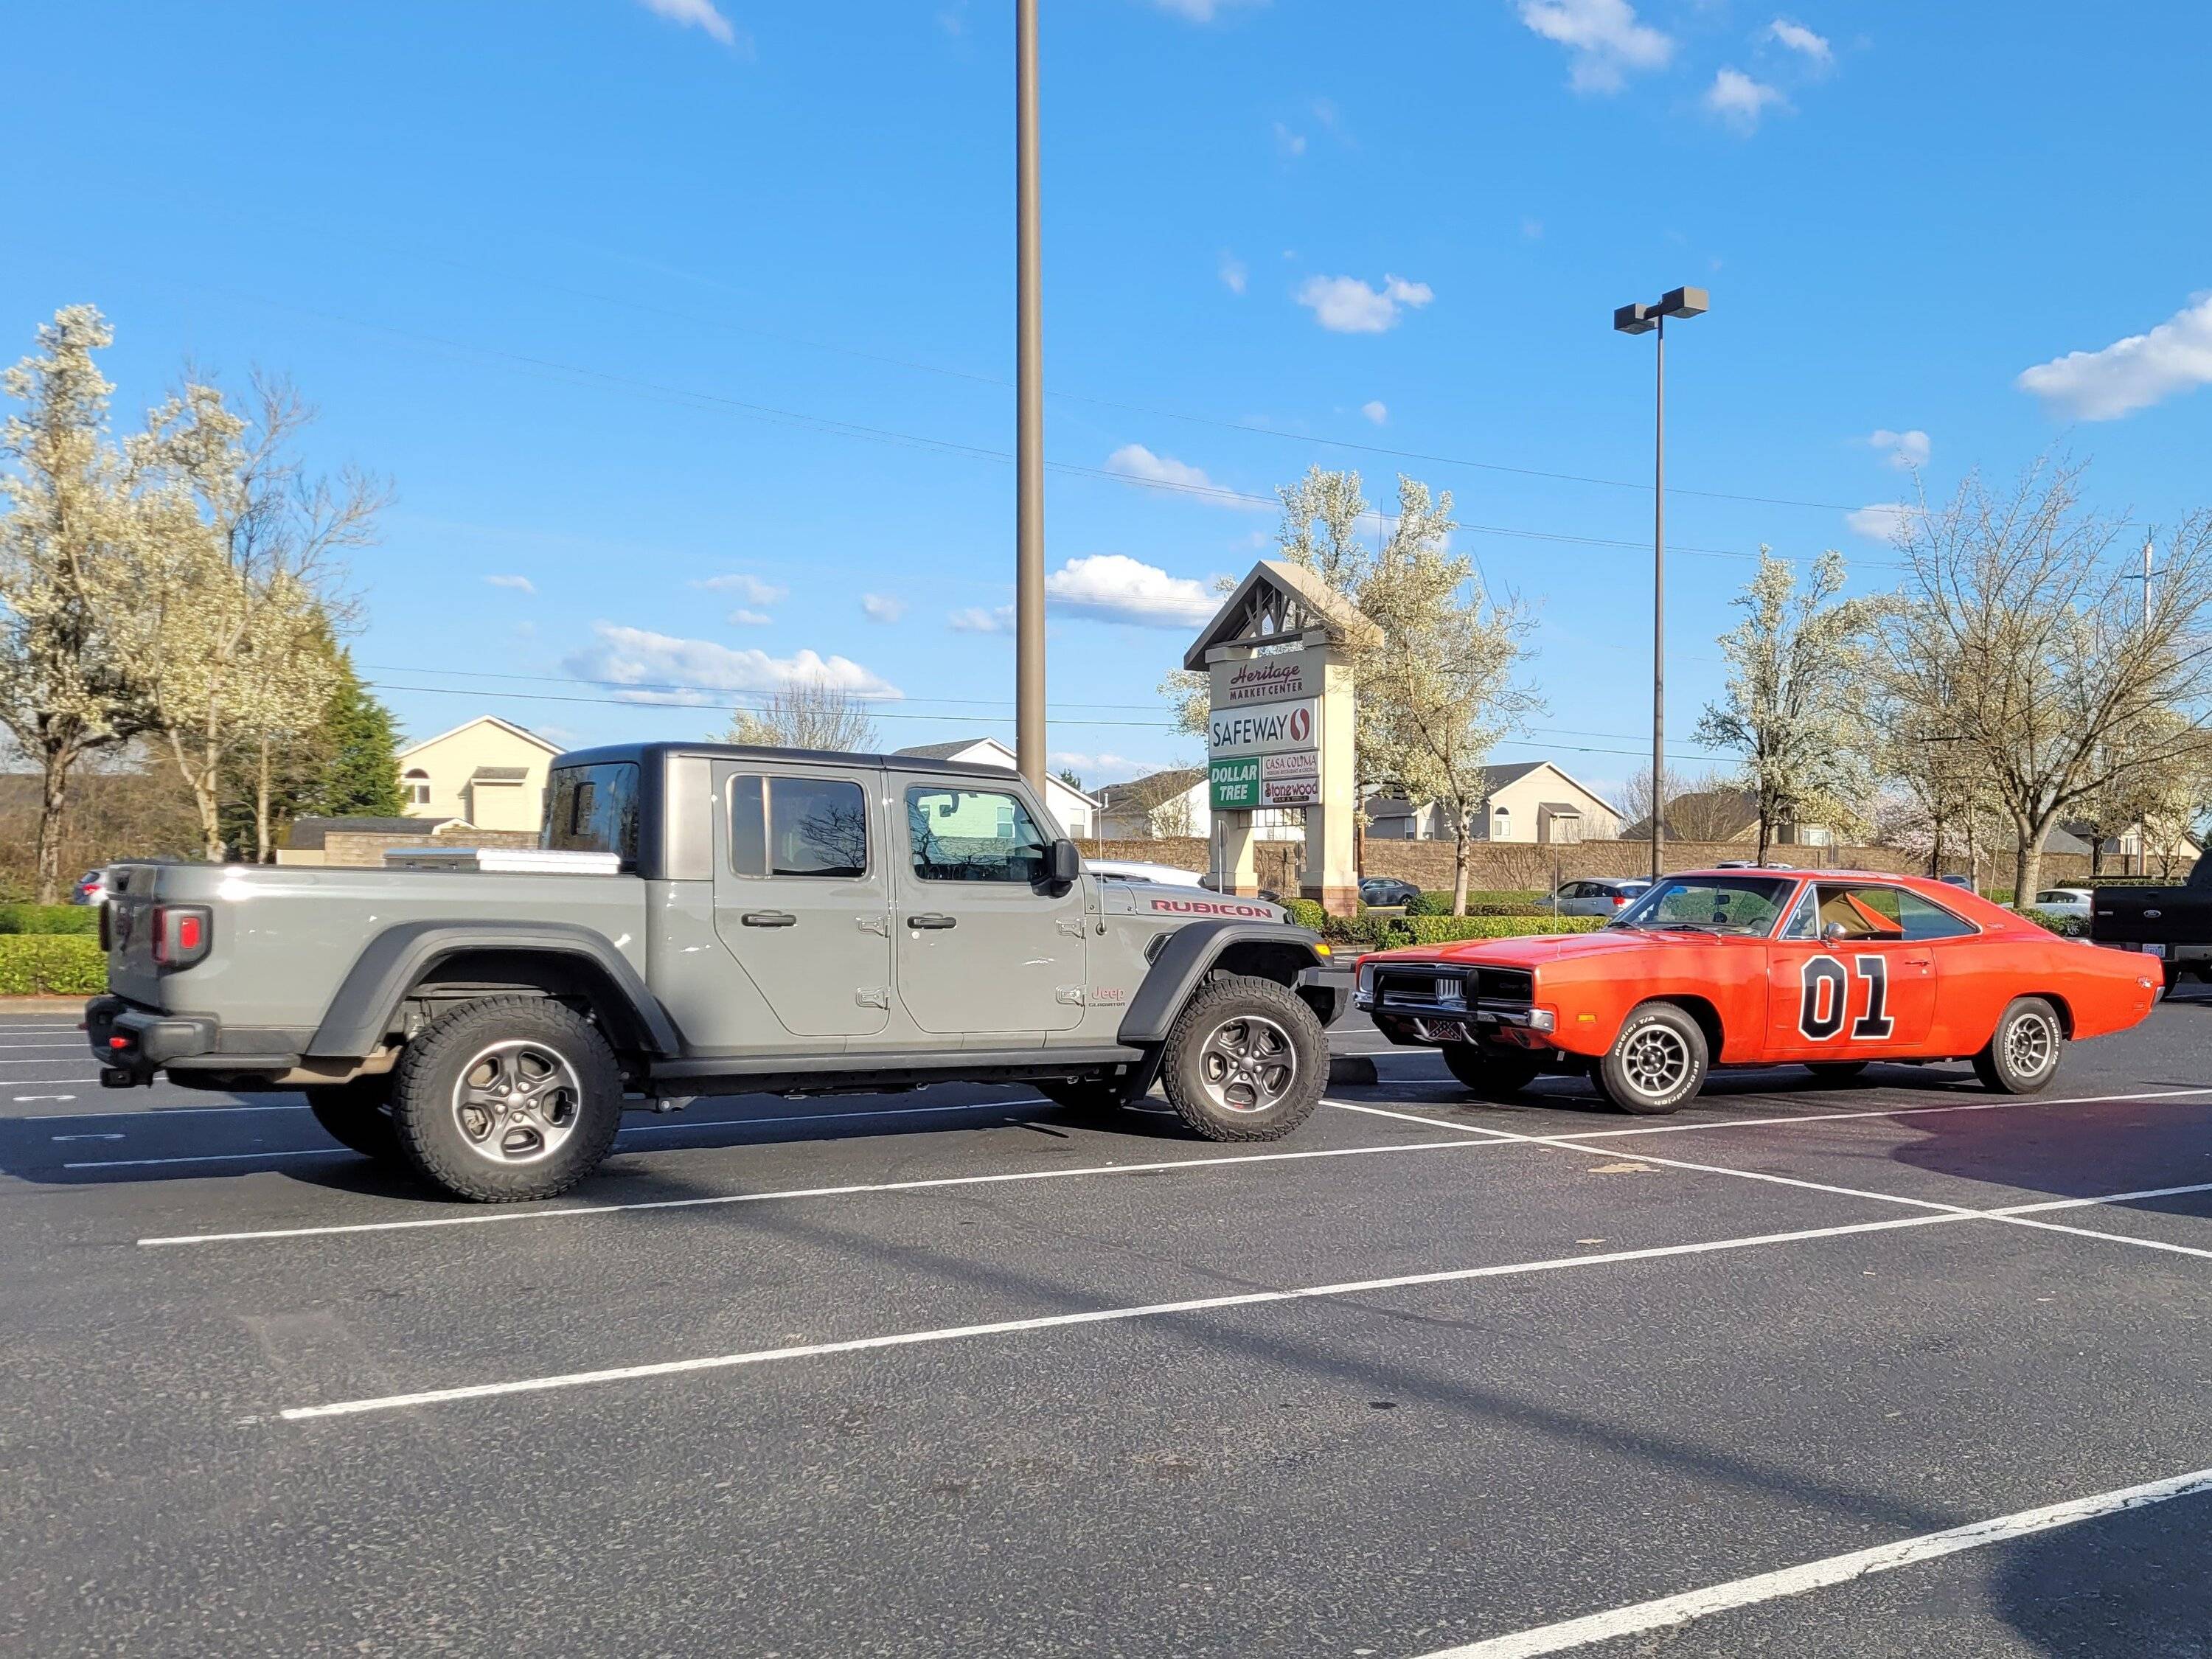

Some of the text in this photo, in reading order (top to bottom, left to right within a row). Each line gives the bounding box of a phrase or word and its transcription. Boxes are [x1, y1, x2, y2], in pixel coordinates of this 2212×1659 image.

[1231, 661, 1300, 684] Heritage
[1230, 682, 1303, 700] MARKET CENTER
[1213, 714, 1288, 747] SAFEWAY
[1266, 755, 1317, 770] CASA COLIMA
[1211, 765, 1257, 783] DOLLAR
[1220, 784, 1248, 801] TREE
[1265, 779, 1318, 797] Stonewood
[1150, 899, 1273, 919] RUBICON
[1091, 985, 1124, 1001] Jeep
[1798, 954, 1894, 1041] 01
[1615, 1015, 1655, 1057] Radial T/A
